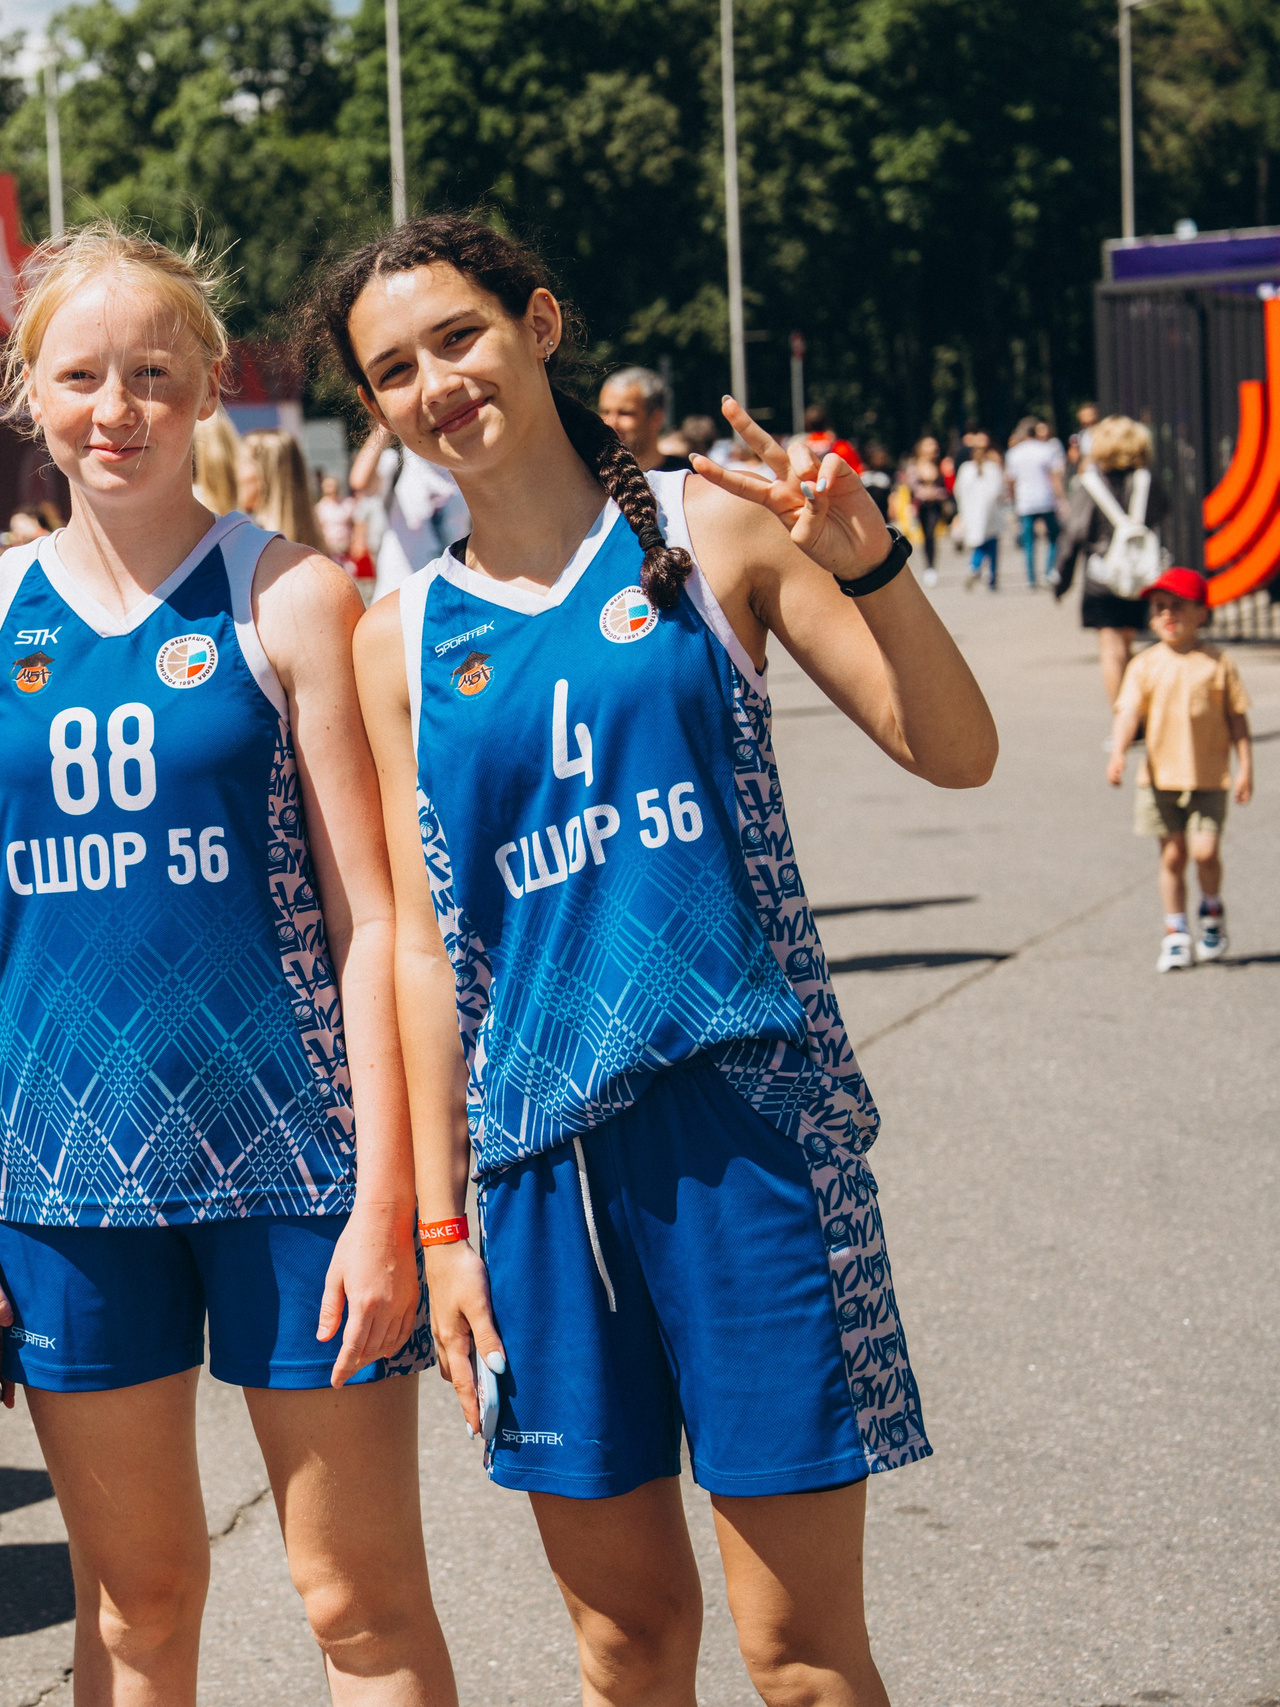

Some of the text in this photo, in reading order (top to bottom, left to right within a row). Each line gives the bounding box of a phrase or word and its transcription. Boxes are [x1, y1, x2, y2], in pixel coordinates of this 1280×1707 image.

[14, 626, 62, 645] STK
[49, 702, 157, 815] 88
[552, 678, 593, 787] 4
[6, 826, 229, 895] СШОР 56
[494, 803, 620, 899] СШОР
[636, 781, 704, 849] 56
